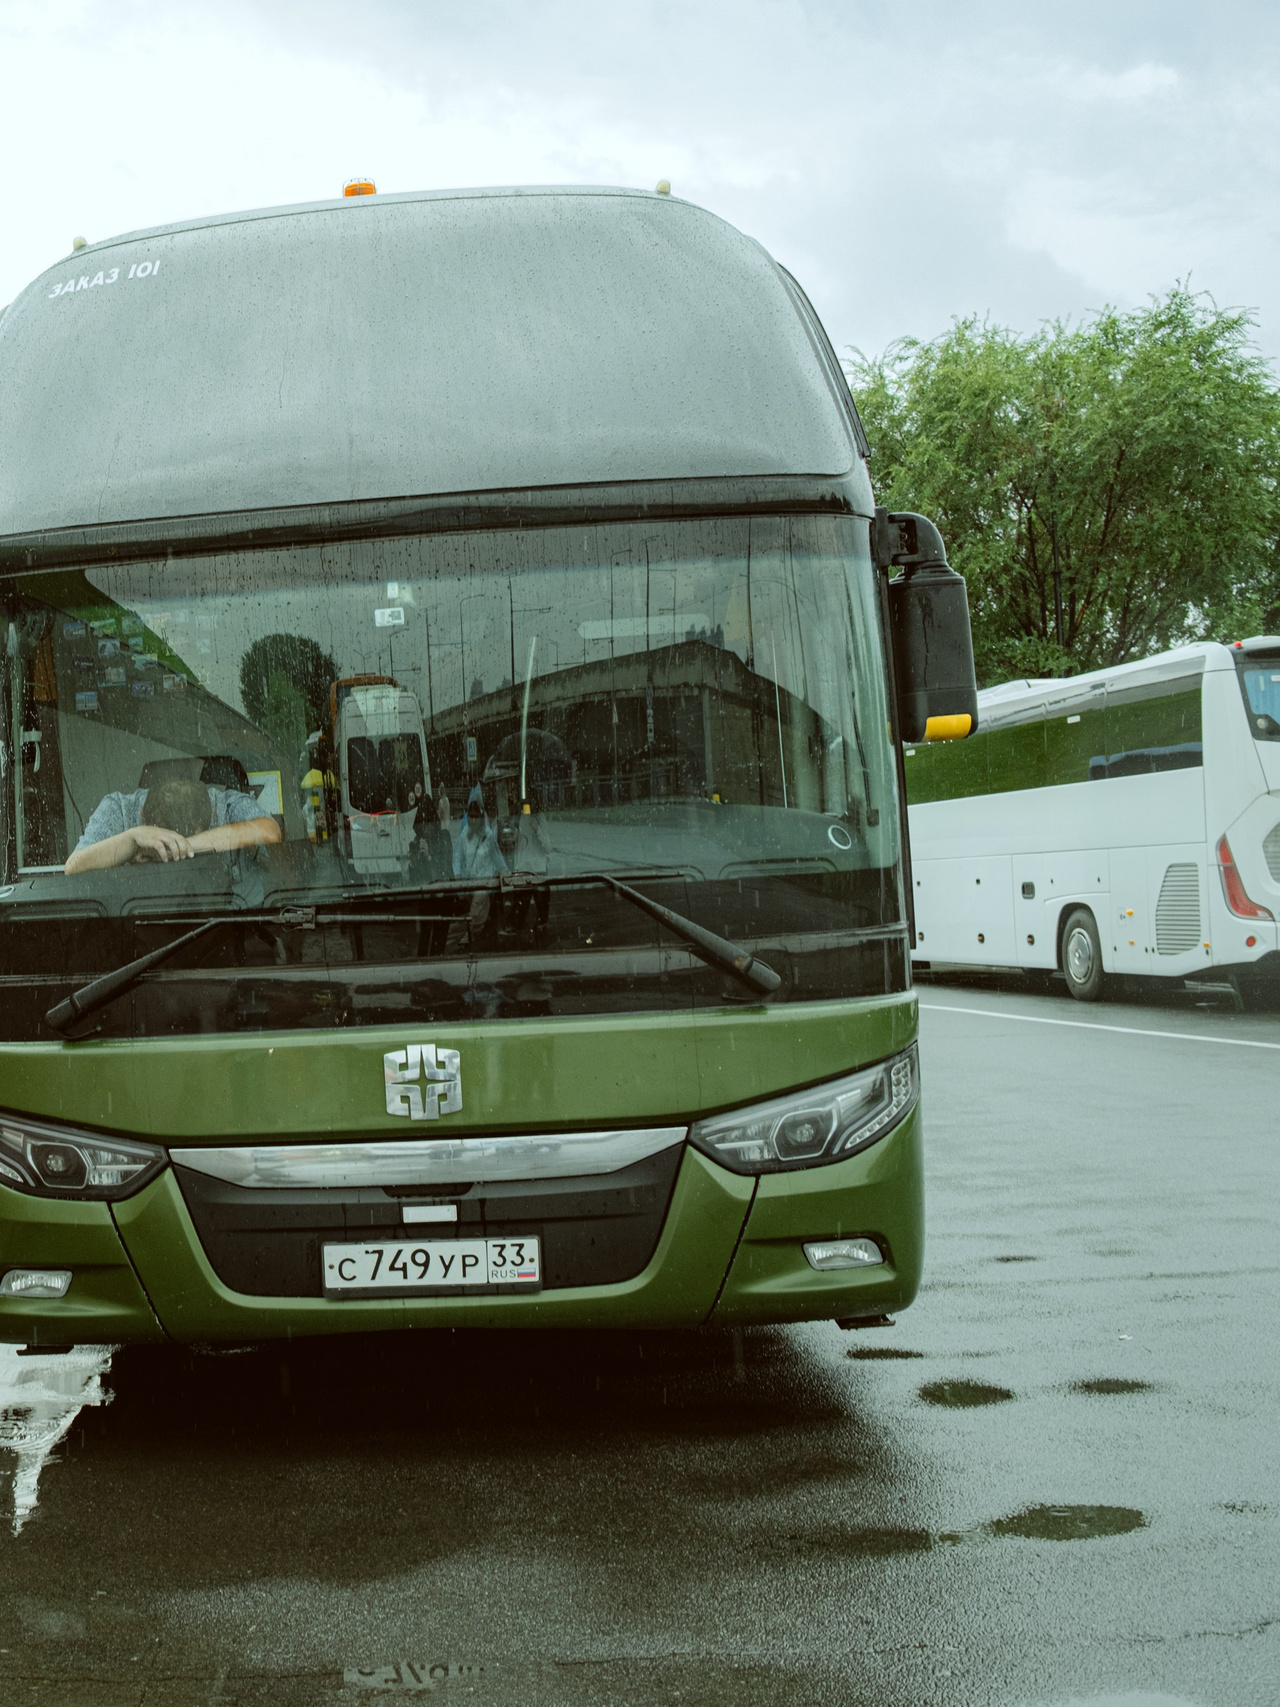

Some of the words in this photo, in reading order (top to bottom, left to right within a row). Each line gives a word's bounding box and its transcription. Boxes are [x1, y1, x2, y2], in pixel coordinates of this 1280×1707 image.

[48, 267, 119, 298] ЗАКАЗ
[492, 1243, 525, 1267] 33
[491, 1269, 516, 1279] RUS
